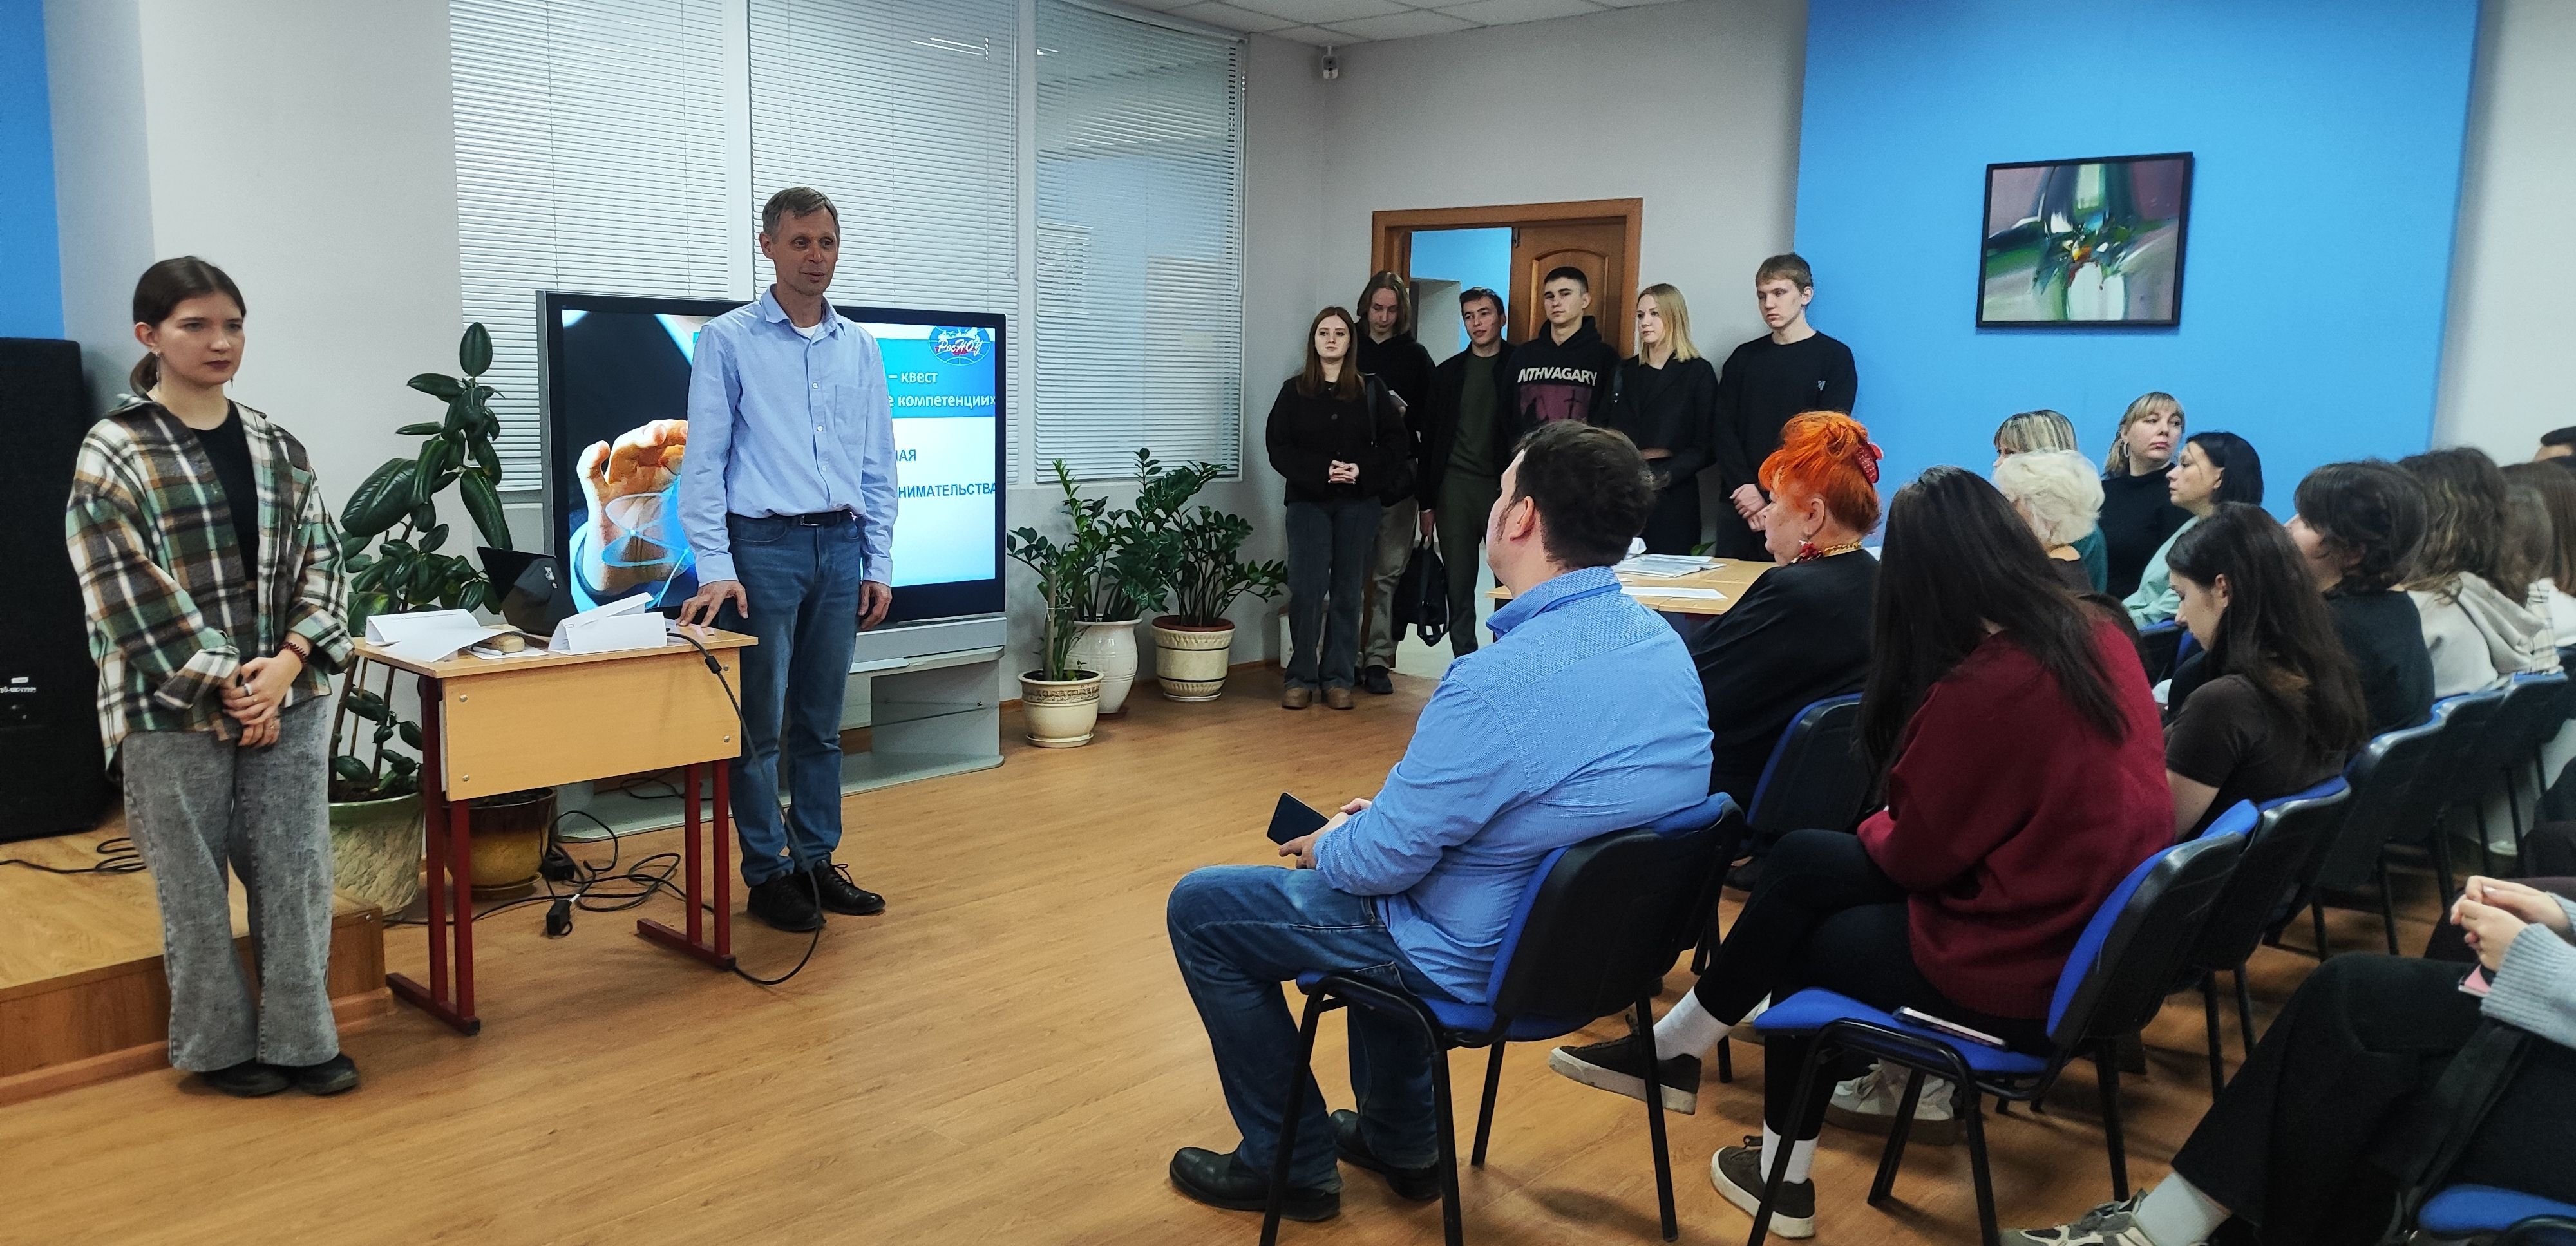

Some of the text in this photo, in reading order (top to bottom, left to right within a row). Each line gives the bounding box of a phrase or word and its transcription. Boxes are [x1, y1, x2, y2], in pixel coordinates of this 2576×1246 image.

[938, 338, 983, 357] РосНОУ
[901, 372, 938, 384] квест
[1517, 366, 1597, 386] NTHVAGARY
[896, 449, 916, 462] АЯ
